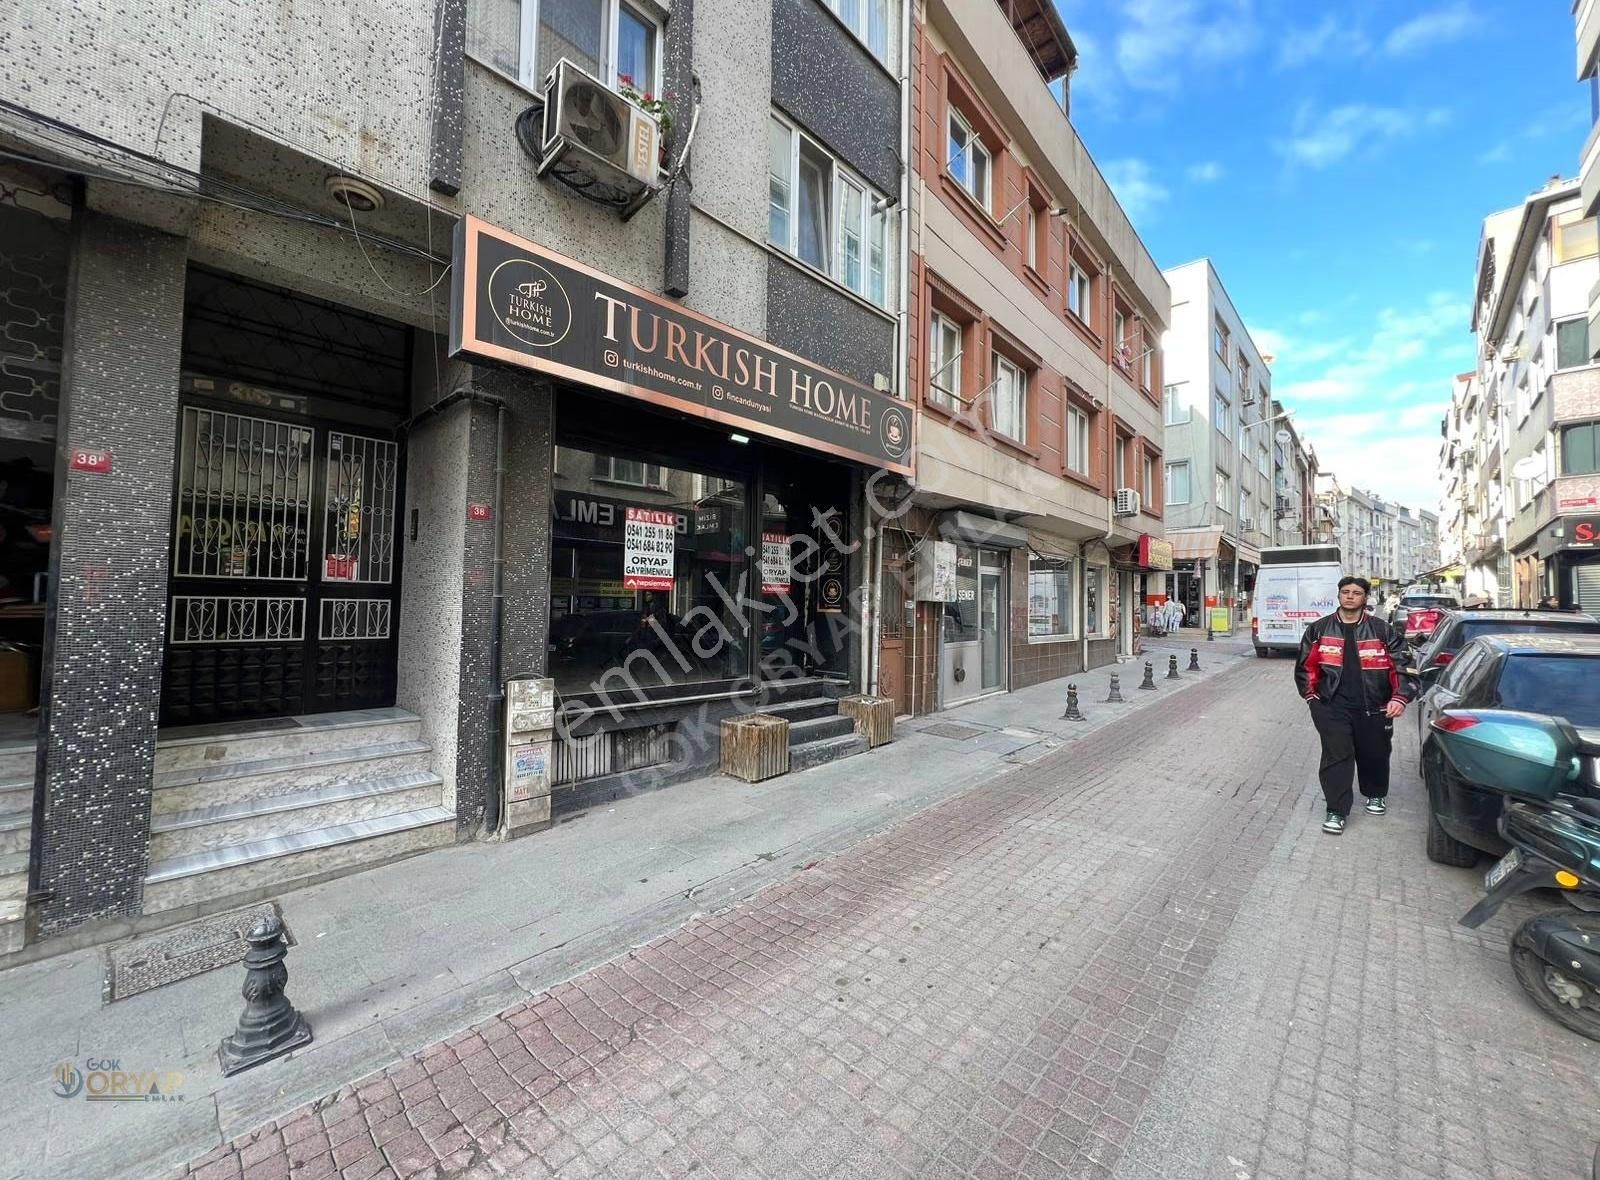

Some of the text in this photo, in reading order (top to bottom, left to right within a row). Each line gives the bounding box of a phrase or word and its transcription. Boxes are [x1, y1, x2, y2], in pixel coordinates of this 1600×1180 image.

[509, 294, 552, 317] TURKISH
[509, 305, 552, 328] HOME
[505, 317, 555, 338] @turkishhome.com.tr
[594, 291, 871, 430] TURKISH HOME
[623, 358, 703, 392] turkishhome.com.tr
[726, 392, 772, 414] fincandunyasi
[474, 507, 485, 516] 38
[628, 509, 674, 525] SATILIK
[626, 524, 674, 541] 0541 255 11 86
[626, 538, 673, 554] 0541 684 82 90
[631, 556, 668, 567] ORYAP
